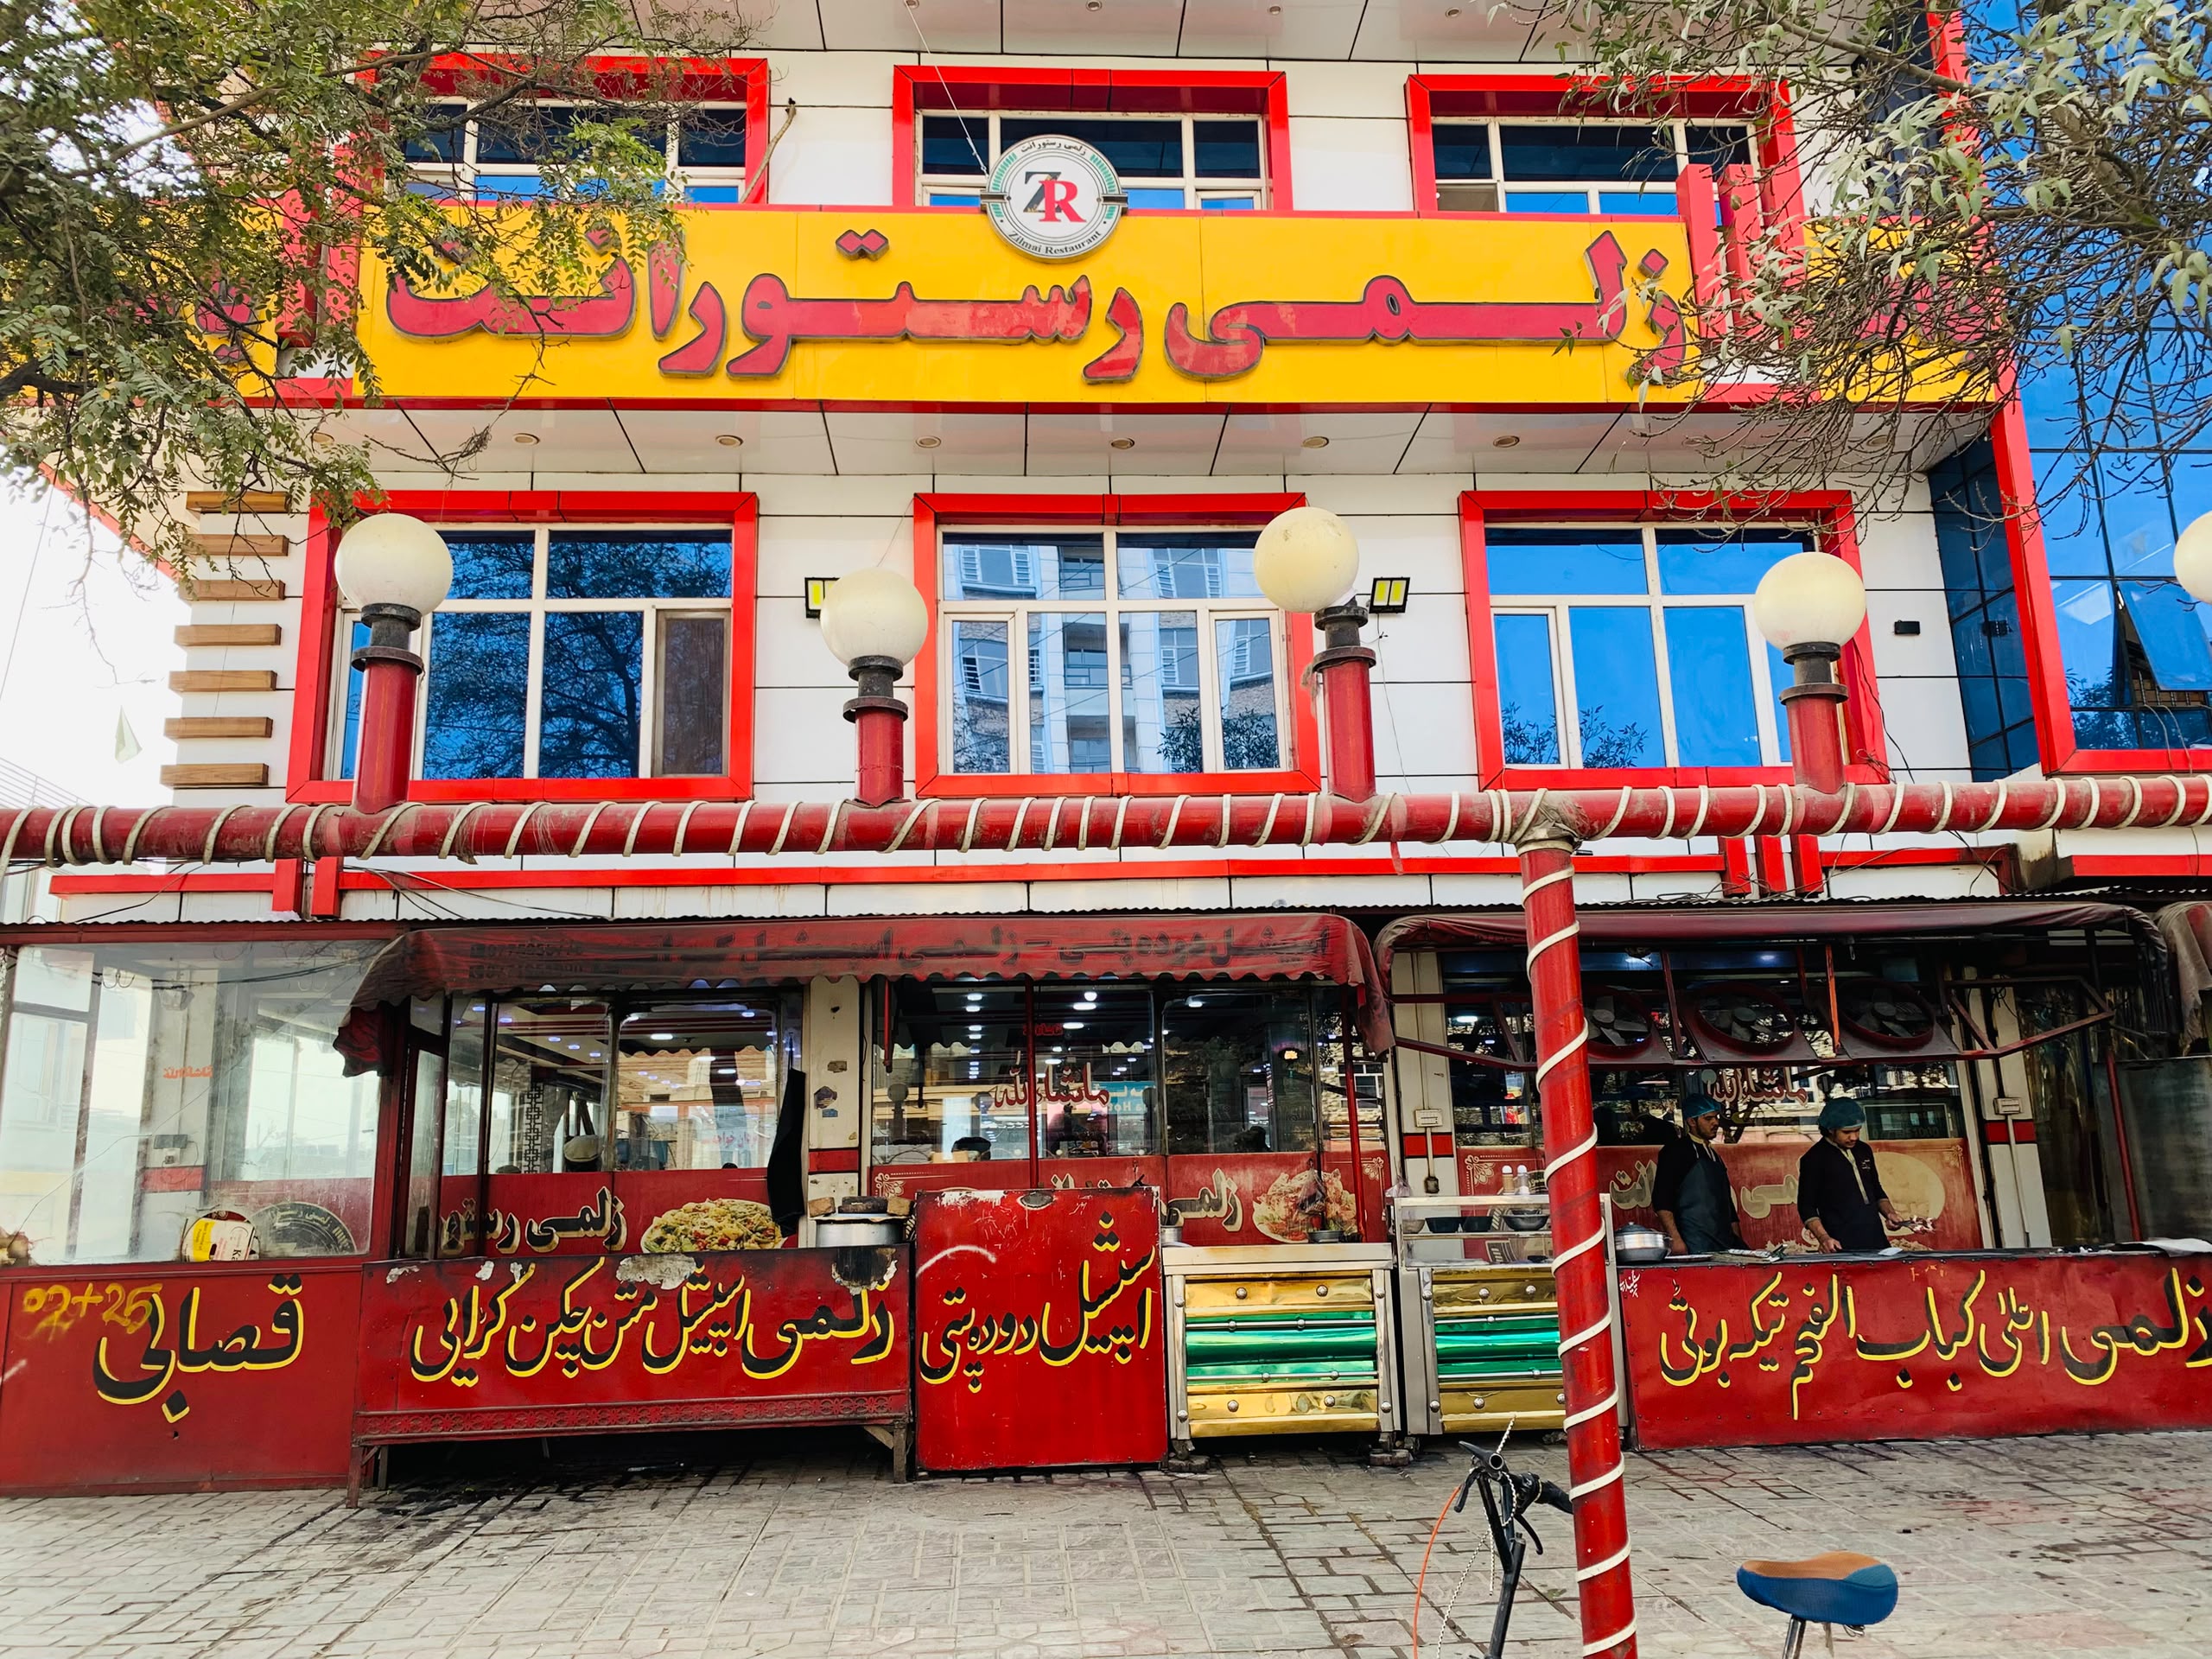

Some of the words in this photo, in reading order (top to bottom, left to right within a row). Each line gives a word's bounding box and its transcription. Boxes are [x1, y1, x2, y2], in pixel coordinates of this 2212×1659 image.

[1007, 230, 1042, 254] Zilmai
[1044, 230, 1103, 256] Restaurant
[1022, 170, 1087, 223] ZR
[1163, 228, 1697, 388] زلمی
[92, 1273, 305, 1424] قصابی
[1856, 1268, 1986, 1393] کباب
